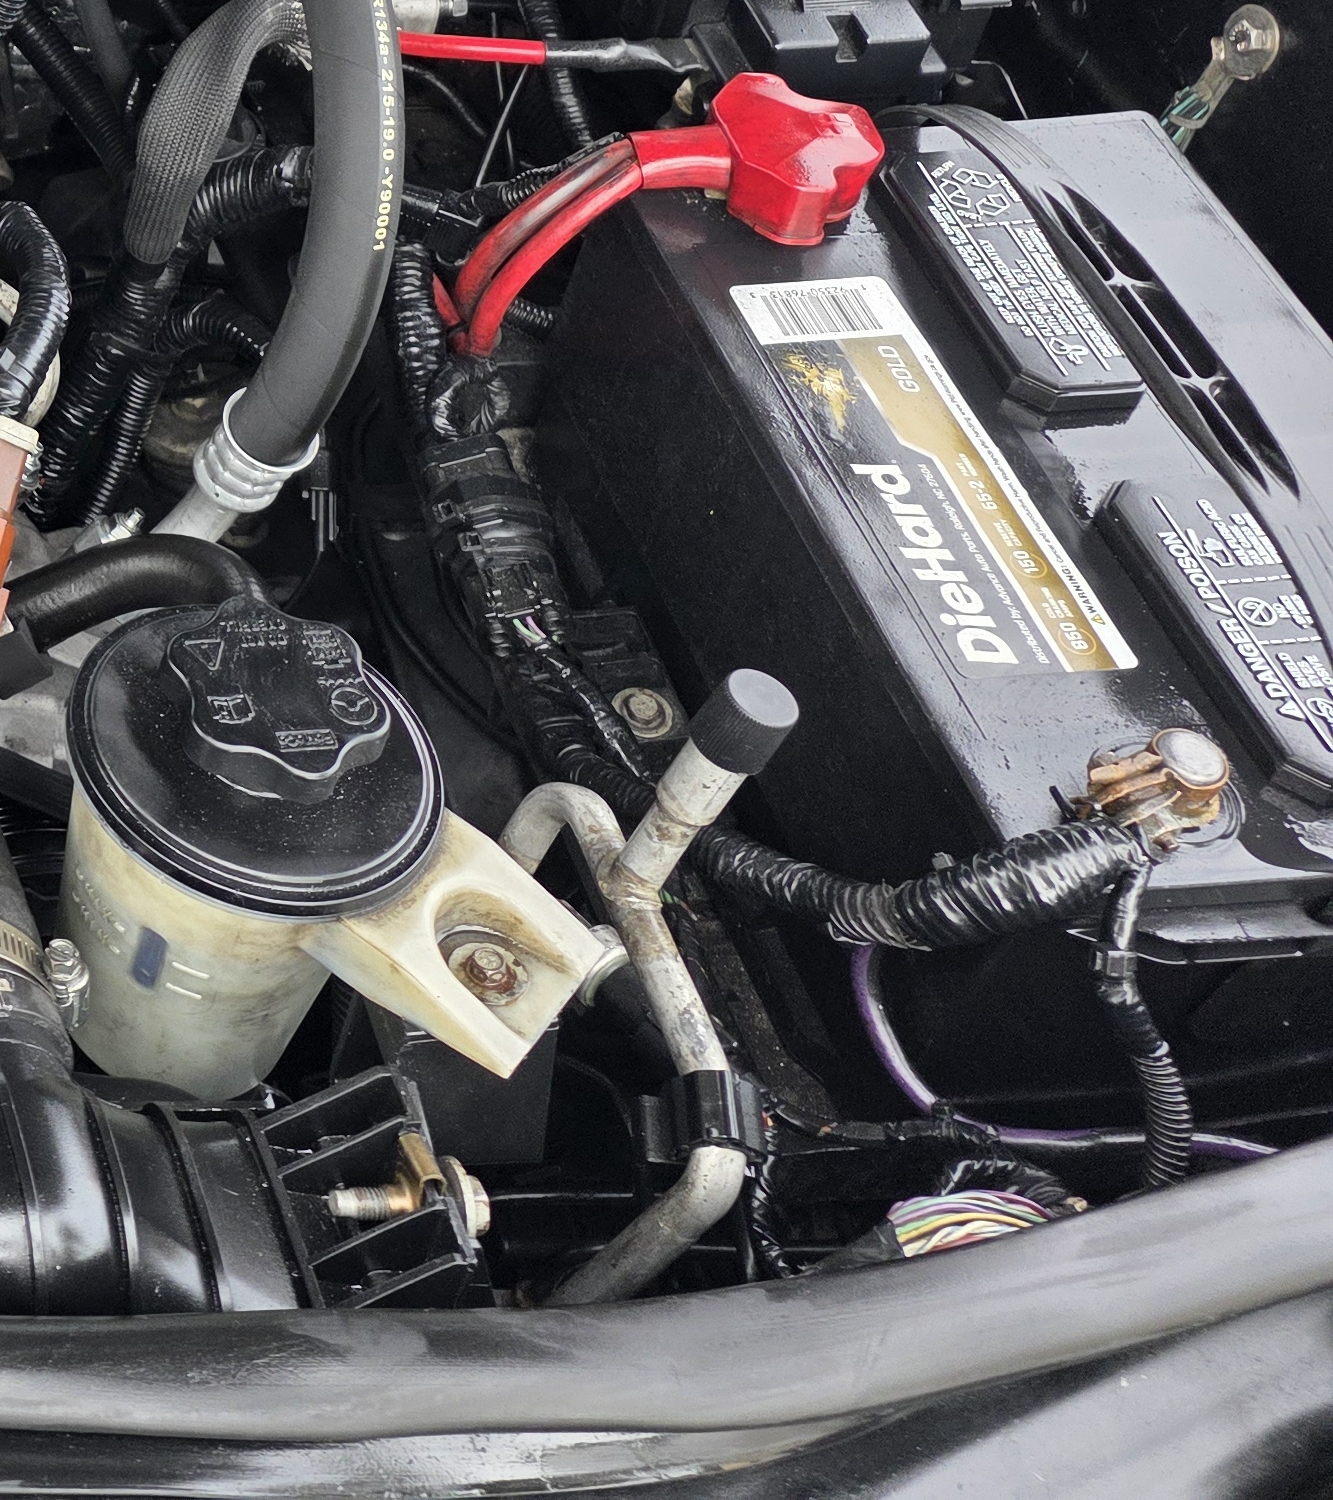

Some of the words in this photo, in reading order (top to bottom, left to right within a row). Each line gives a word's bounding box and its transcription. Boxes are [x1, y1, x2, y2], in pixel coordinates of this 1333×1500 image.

[380, 68, 395, 160] 215-19.0
[372, 166, 394, 252] -Y90001
[978, 238, 1022, 289] IMMEDIATELY
[1011, 267, 1030, 284] GET
[1016, 258, 1038, 278] FAST
[1014, 290, 1036, 311] EYES
[1030, 279, 1053, 300] HELP
[1028, 311, 1054, 336] FLUSH
[1043, 315, 1065, 335] WITH
[1045, 300, 1077, 334] MEDICAL
[878, 345, 920, 393] GOLD
[931, 487, 947, 499] NC
[1196, 499, 1223, 520] ACID
[1212, 523, 1255, 565] SULFURIC
[850, 463, 1019, 664] DieHard
[974, 557, 995, 574] Auto
[1010, 549, 1041, 573] 150
[1158, 531, 1221, 600] POISON
[986, 576, 1016, 608] Advance
[1270, 603, 1291, 617] NO
[1015, 623, 1050, 663] Distributed
[1056, 622, 1090, 649] 850
[1217, 617, 1290, 699] DANGER
[1276, 652, 1311, 687] SHIELD
[1295, 661, 1324, 686] EYES
